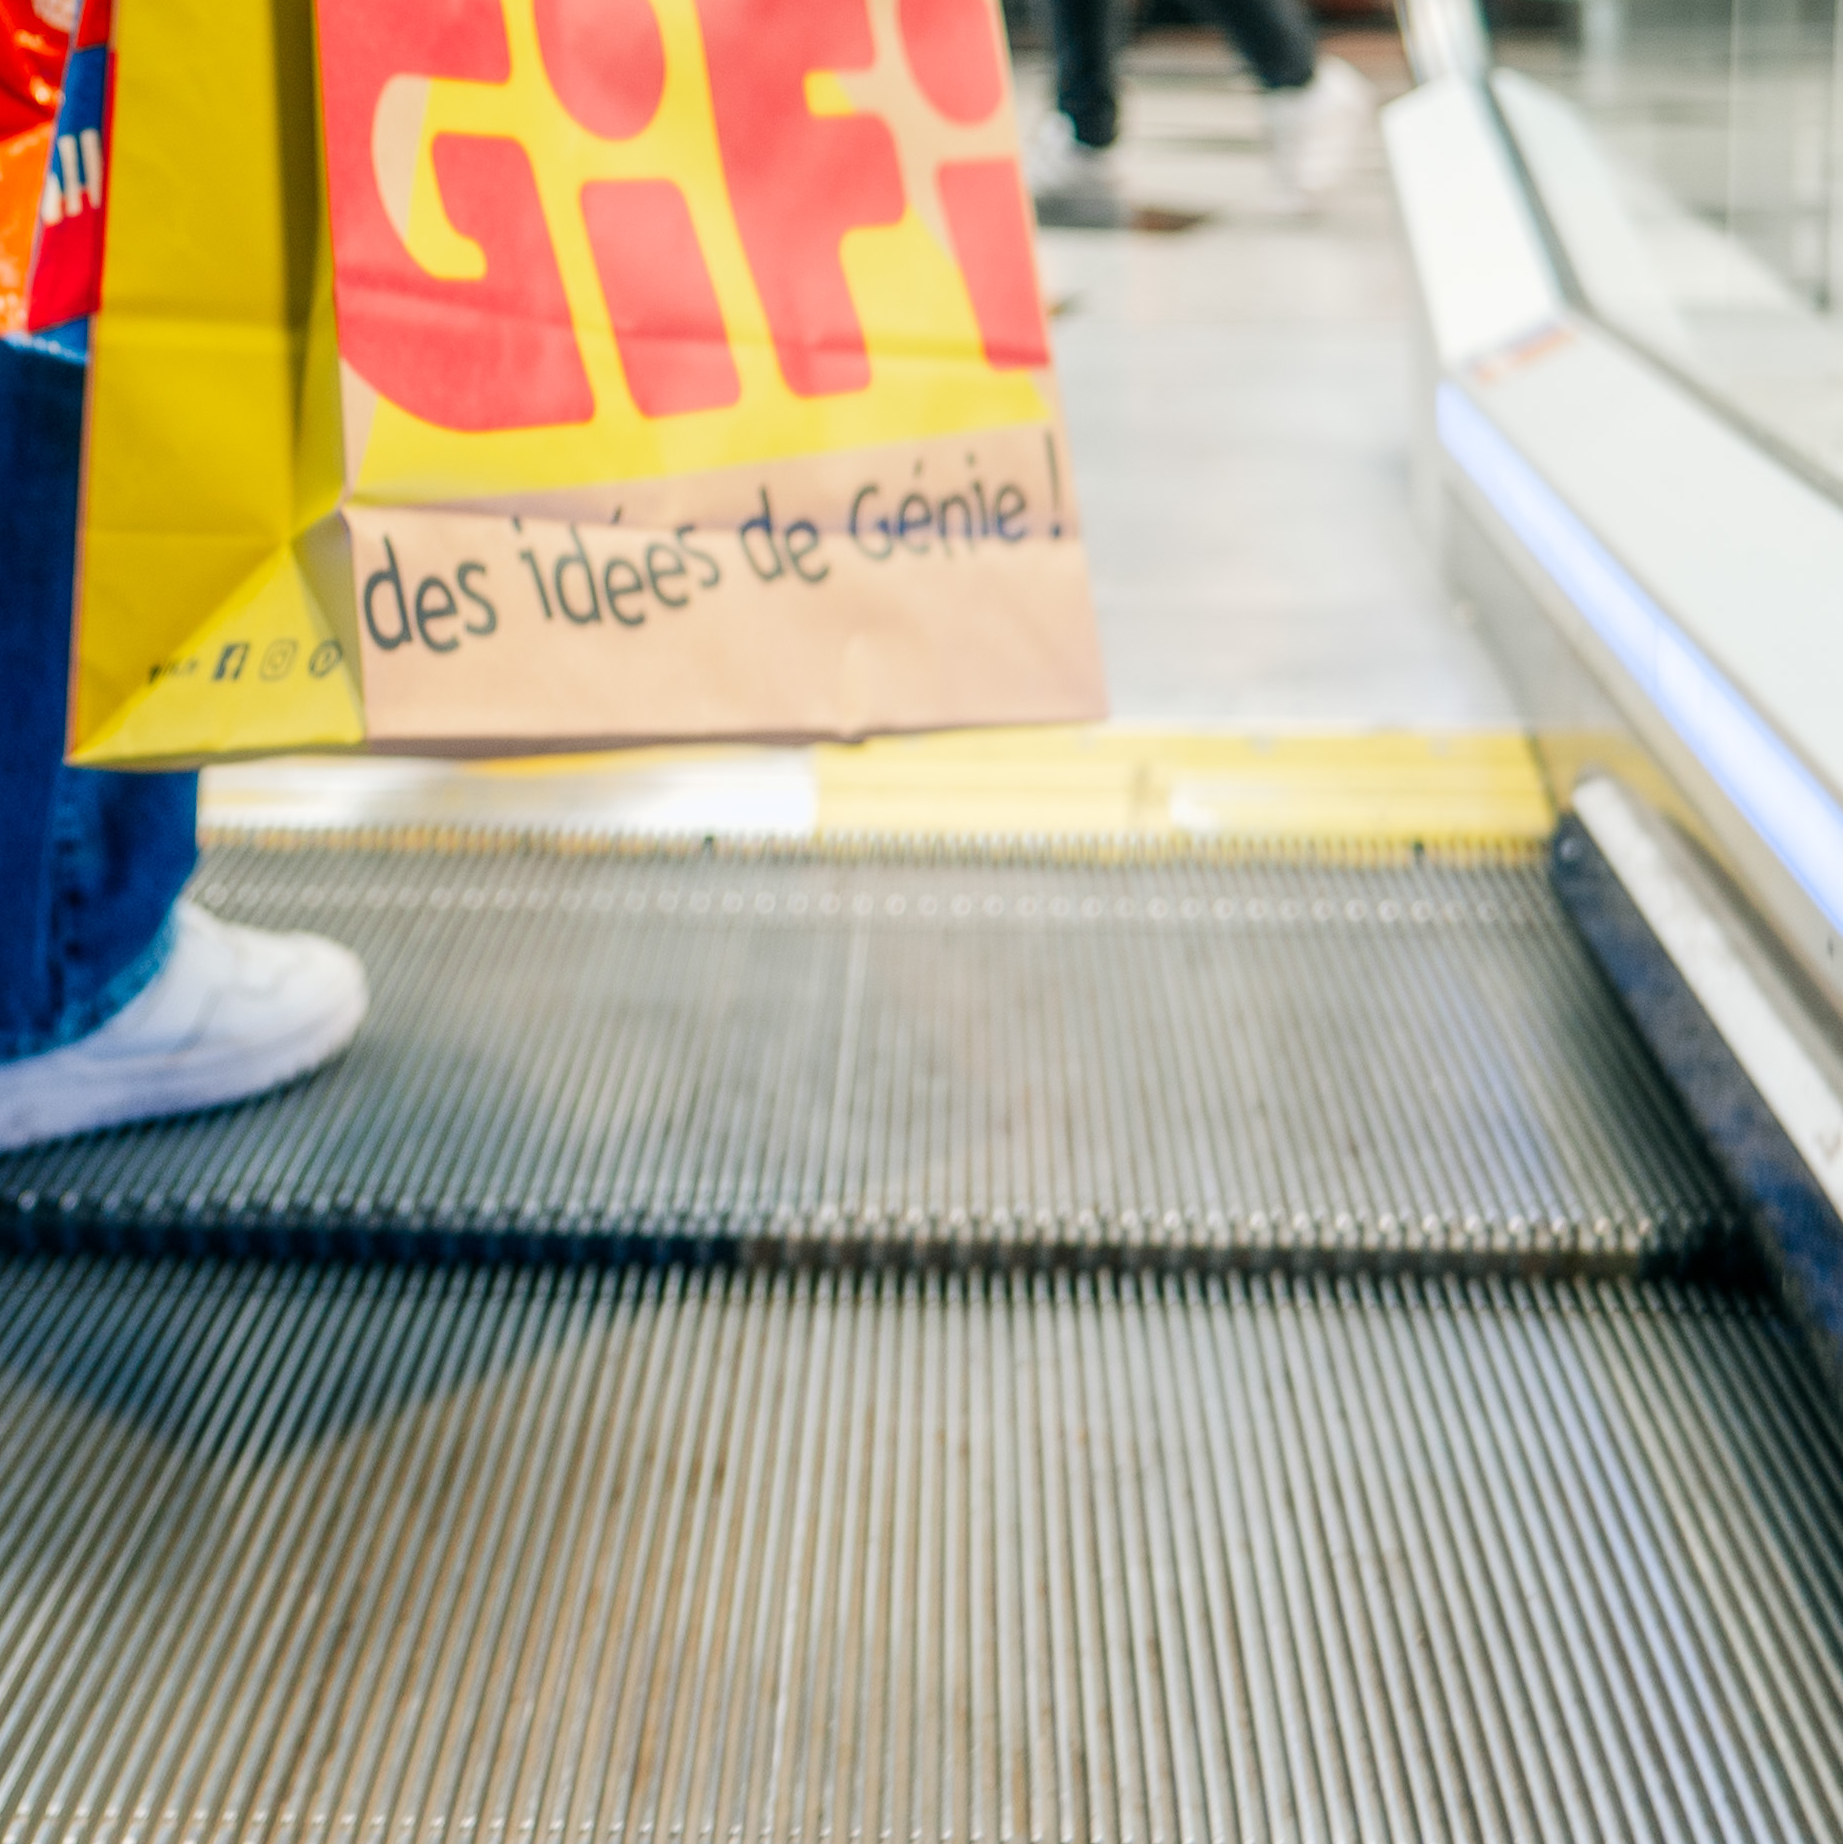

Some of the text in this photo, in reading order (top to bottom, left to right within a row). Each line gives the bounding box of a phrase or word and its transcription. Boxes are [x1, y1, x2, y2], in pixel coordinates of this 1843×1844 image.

[363, 533, 499, 653] des
[511, 505, 722, 627] idées
[738, 481, 831, 585] de
